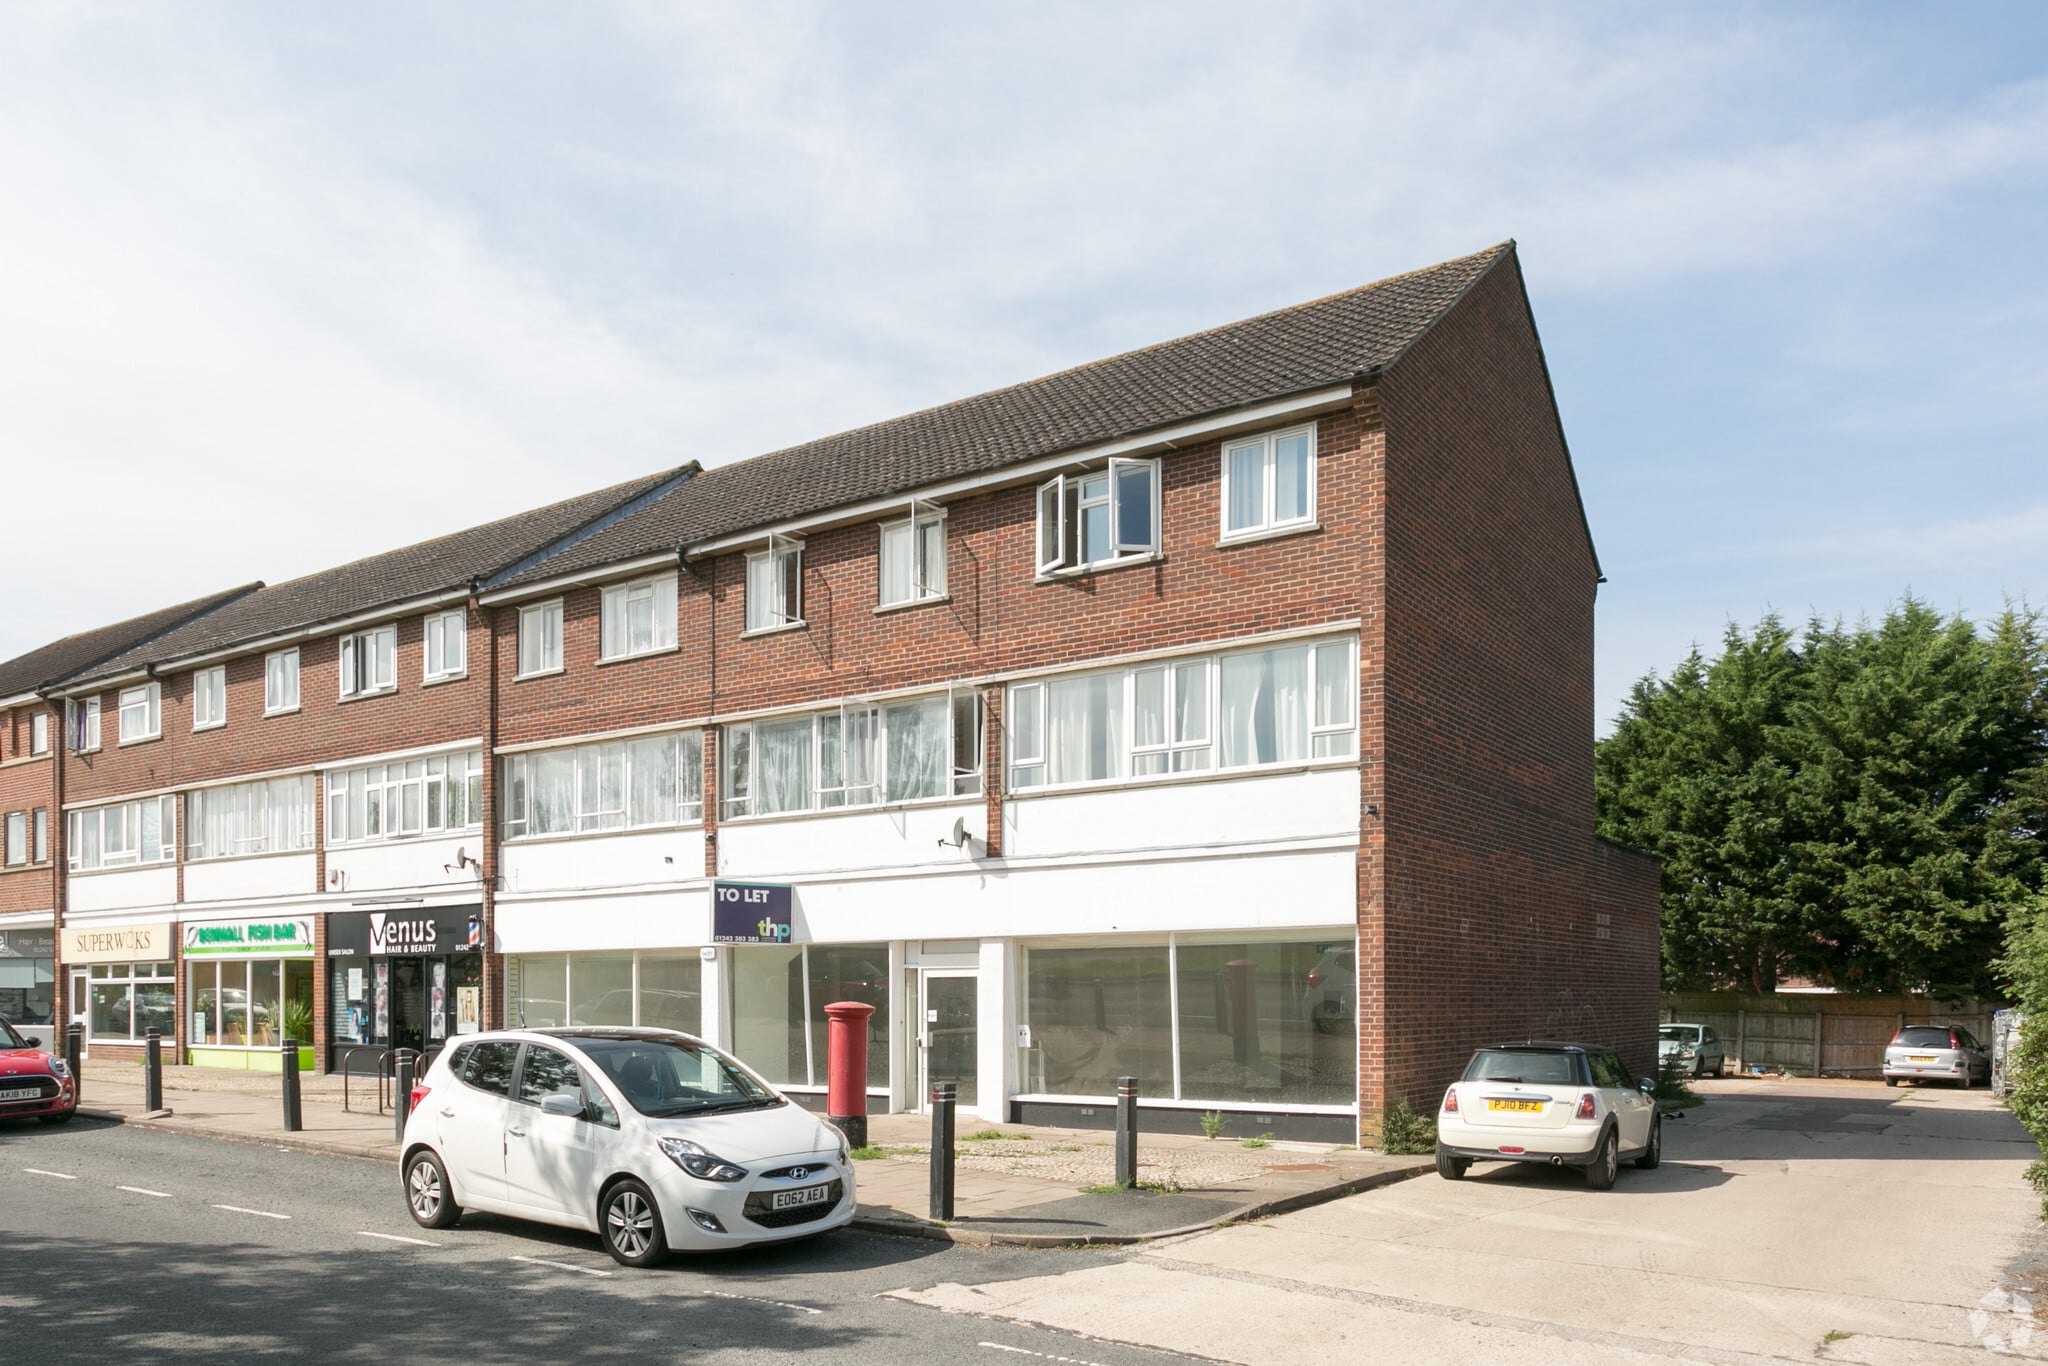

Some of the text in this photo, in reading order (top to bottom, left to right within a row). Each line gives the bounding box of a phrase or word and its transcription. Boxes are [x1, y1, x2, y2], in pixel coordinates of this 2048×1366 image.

[717, 888, 770, 903] TO LET
[248, 924, 272, 942] FISH
[273, 923, 297, 941] BAR
[370, 913, 436, 947] Venus
[757, 916, 791, 943] thp
[77, 931, 151, 952] SUPERWOKS
[386, 945, 402, 953] HAIR
[410, 944, 437, 952] BEAUTY
[1494, 1100, 1538, 1111] PJ10 BFZ
[806, 1187, 825, 1202] AEA
